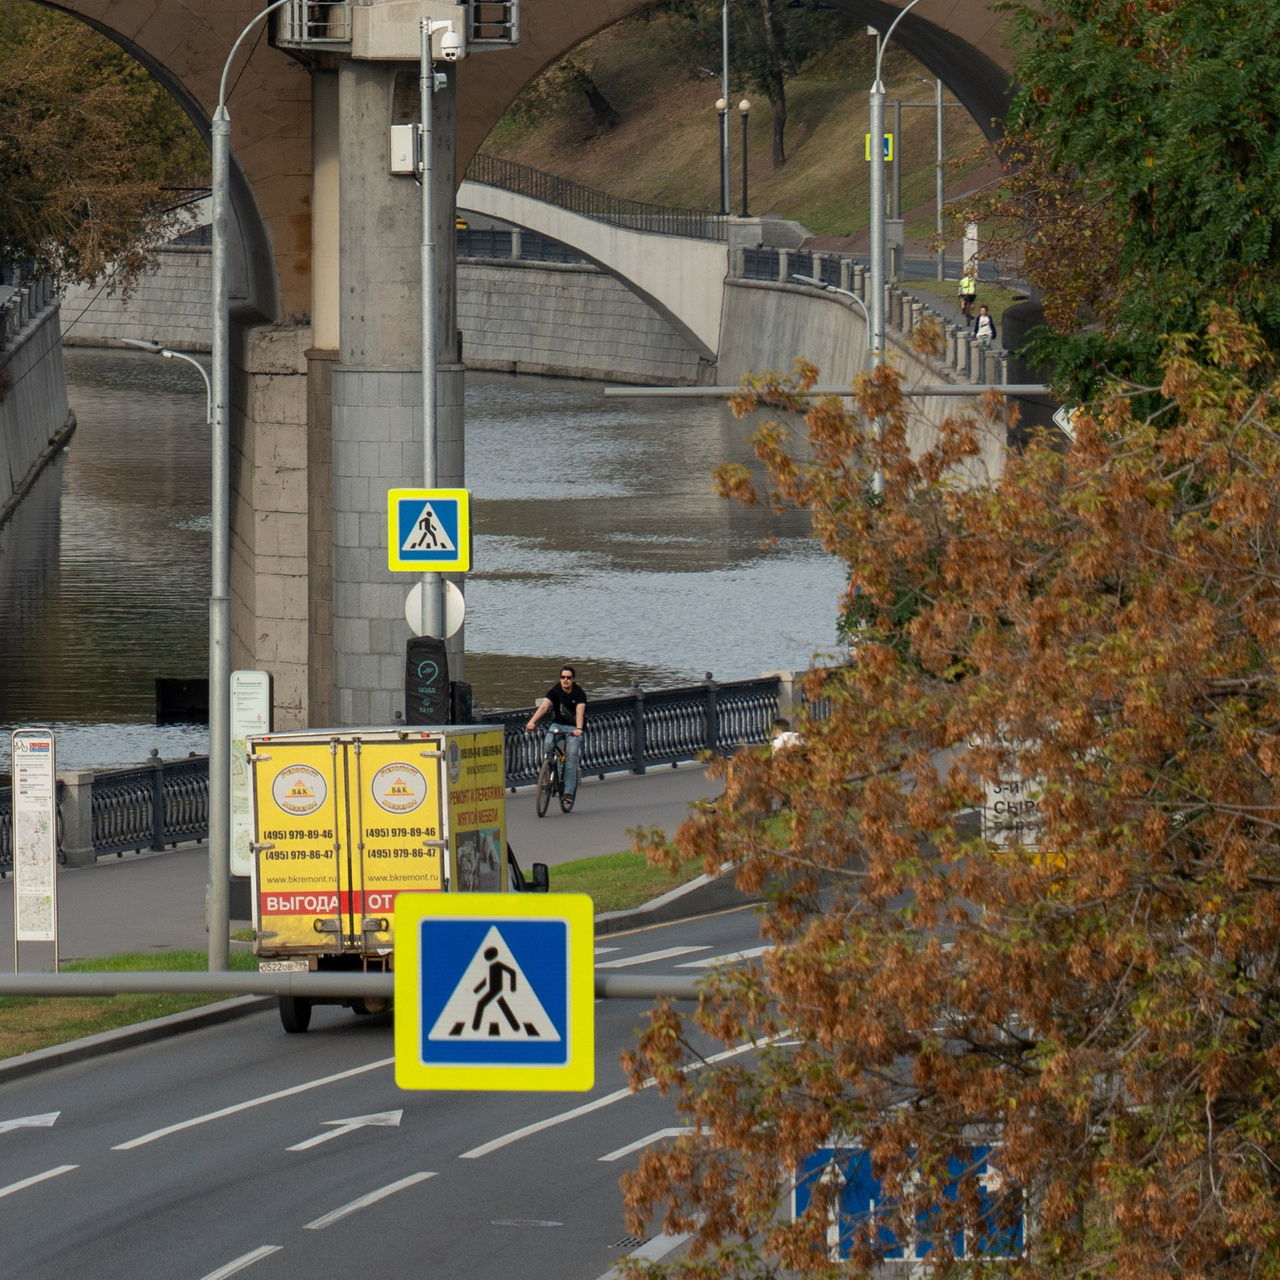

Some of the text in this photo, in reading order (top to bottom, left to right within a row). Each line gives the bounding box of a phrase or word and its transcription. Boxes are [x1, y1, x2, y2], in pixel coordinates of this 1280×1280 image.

[291, 787, 309, 796] B&K
[391, 786, 408, 794] B&K
[263, 829, 333, 840] (495) 979-89-46
[366, 827, 436, 838] (495) 979-89-46
[265, 850, 333, 861] (495) 979-86-47
[367, 848, 436, 859] (495) 979-86-47
[266, 875, 337, 884] www.bkremont.ru
[367, 873, 439, 882] www.bkremont.ru
[266, 894, 393, 913] ВЫГОДА ОТ
